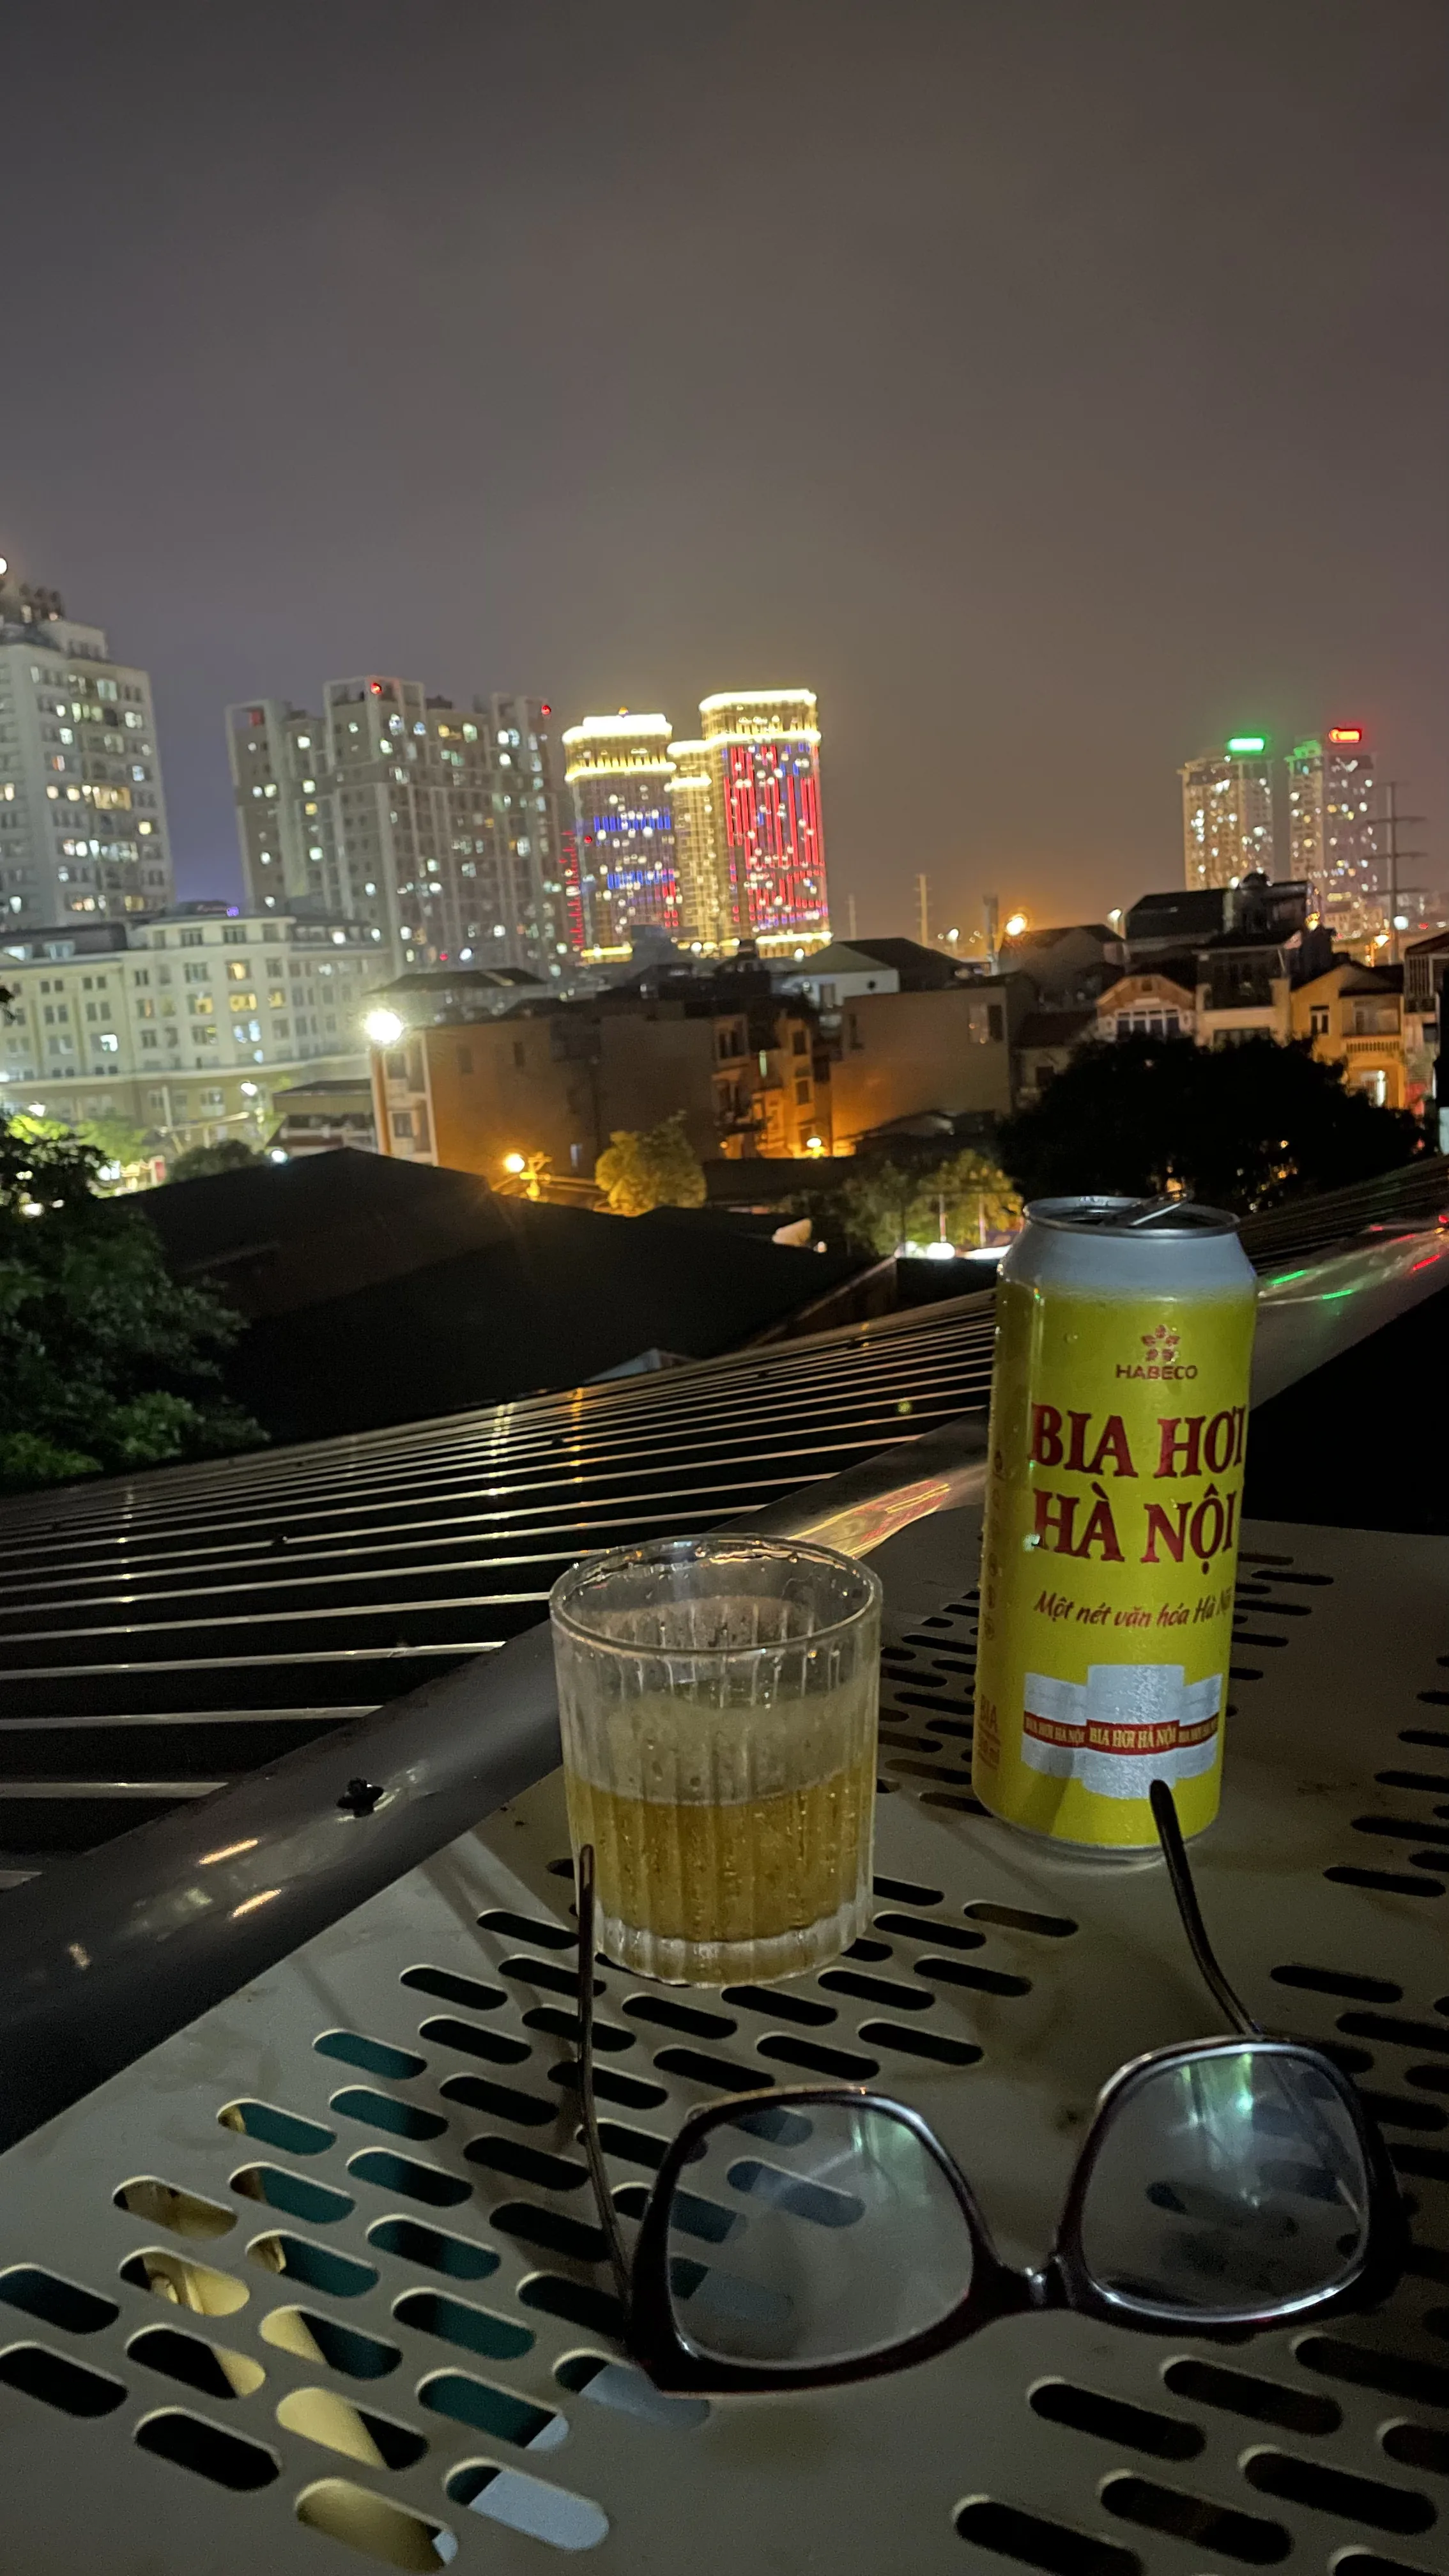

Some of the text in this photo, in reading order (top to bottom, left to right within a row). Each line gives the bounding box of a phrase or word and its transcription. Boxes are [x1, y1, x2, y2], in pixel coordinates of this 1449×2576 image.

[1116, 1364, 1198, 1379] HABECO
[1029, 1401, 1246, 1479] BIA HƠI
[1032, 1481, 1125, 1562] HÀ
[1140, 1482, 1237, 1575] NỘI
[1033, 1590, 1075, 1622] Một
[1076, 1602, 1112, 1625] nét
[1114, 1606, 1152, 1629] văn
[1156, 1602, 1190, 1627] hóa
[1192, 1595, 1216, 1624] Hà
[1089, 1727, 1110, 1746] BIA
